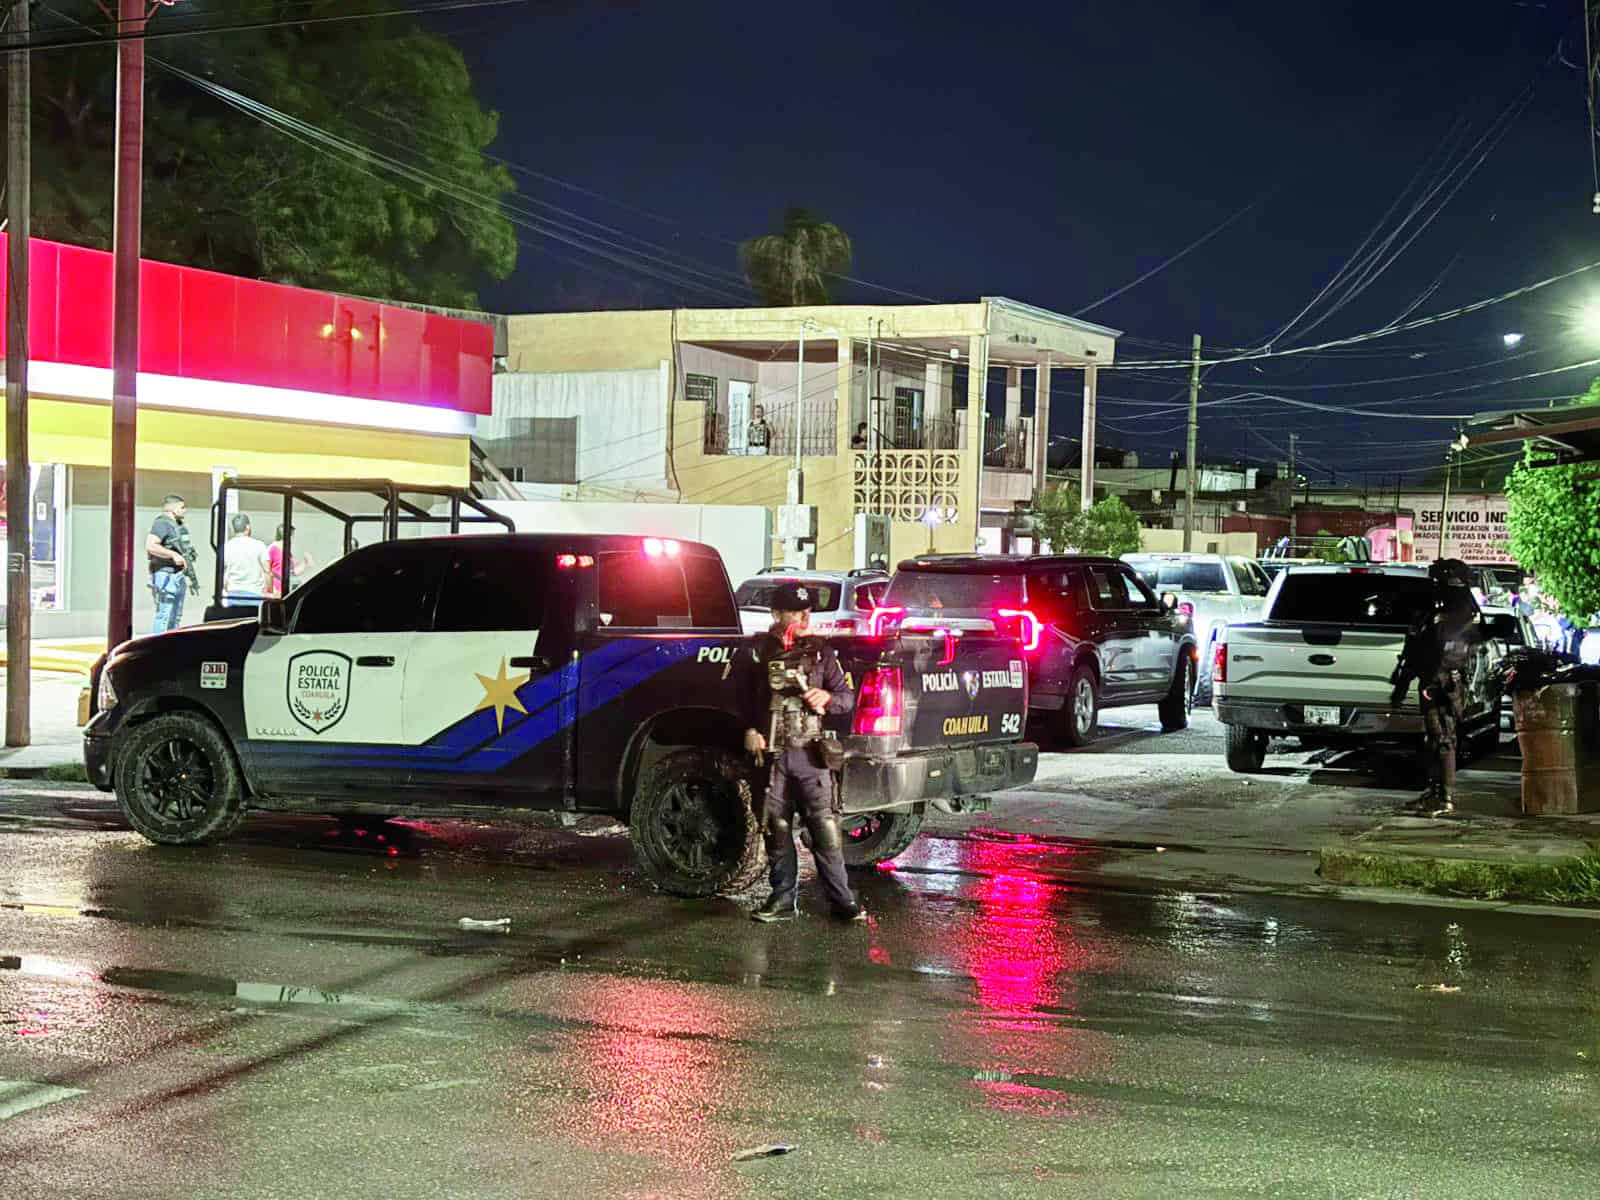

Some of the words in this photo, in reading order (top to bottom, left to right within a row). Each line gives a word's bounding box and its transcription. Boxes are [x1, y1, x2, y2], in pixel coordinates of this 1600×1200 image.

[1421, 510, 1480, 523] SERVICIO
[298, 678, 341, 690] ESTATAL
[921, 667, 960, 693] POLICÍA
[982, 670, 1012, 689] ESTATAL
[943, 714, 989, 736] COAHUILA
[1000, 712, 1020, 734] 542
